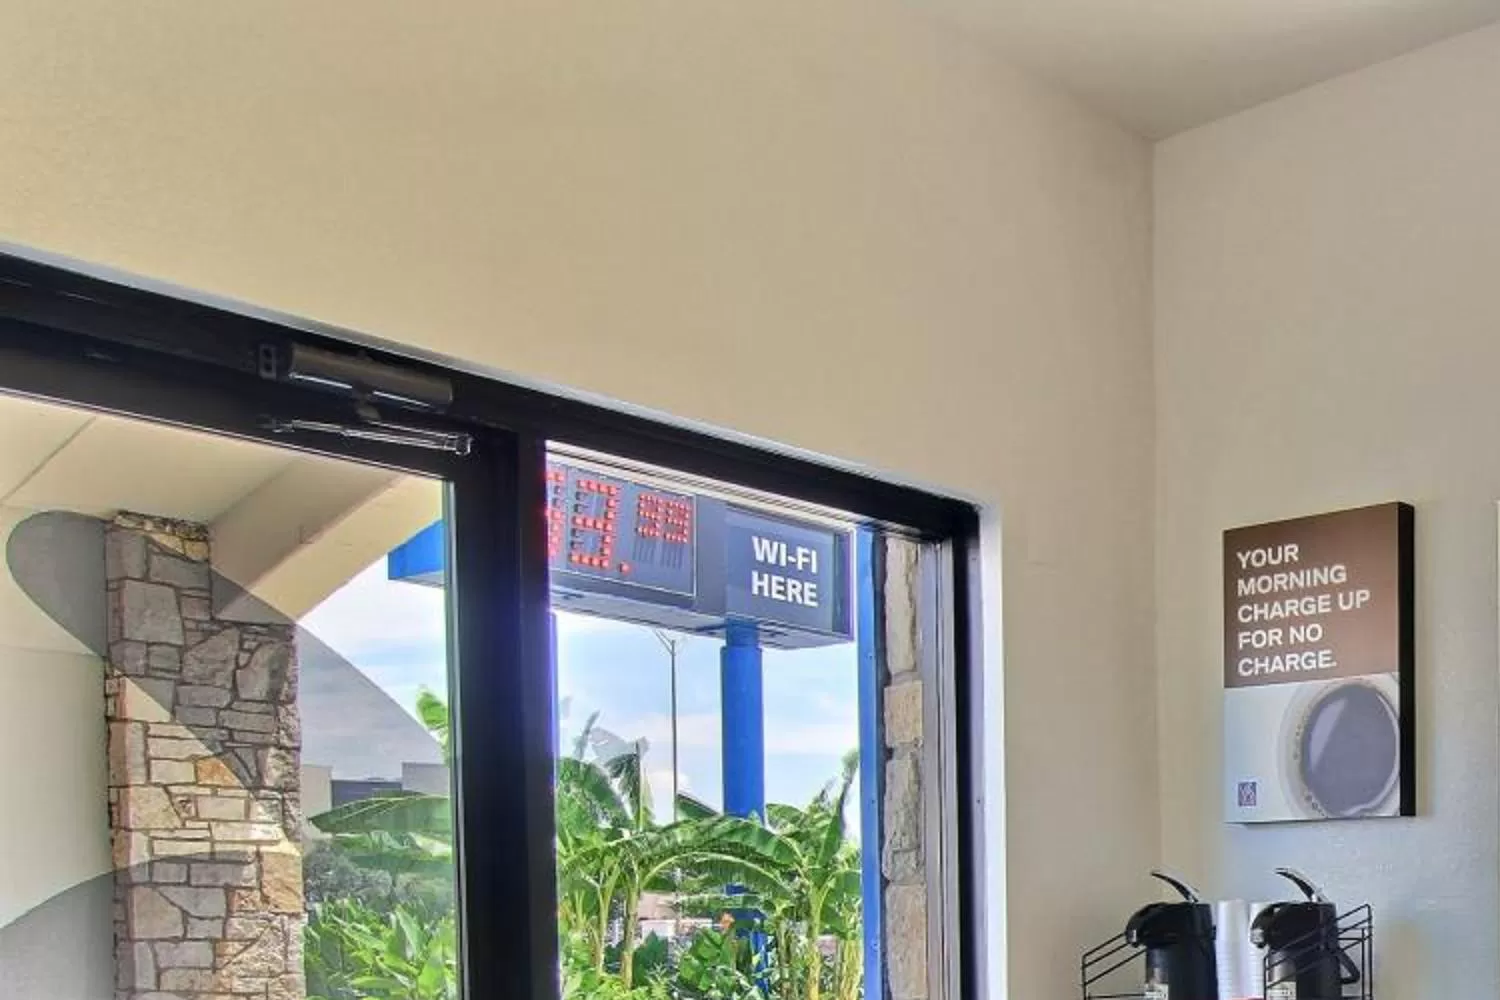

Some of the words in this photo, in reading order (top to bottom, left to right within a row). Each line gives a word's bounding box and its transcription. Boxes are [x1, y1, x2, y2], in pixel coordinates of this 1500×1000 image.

[751, 535, 818, 574] WI-FI
[1237, 543, 1299, 570] YOUR
[751, 571, 819, 608] HERE
[1237, 564, 1348, 597] MORNING
[1238, 595, 1332, 624] CHARGE
[1338, 589, 1371, 611] UP
[1238, 628, 1283, 650] FOR
[1290, 623, 1323, 643] NO
[1238, 650, 1338, 677] CHARGE.
